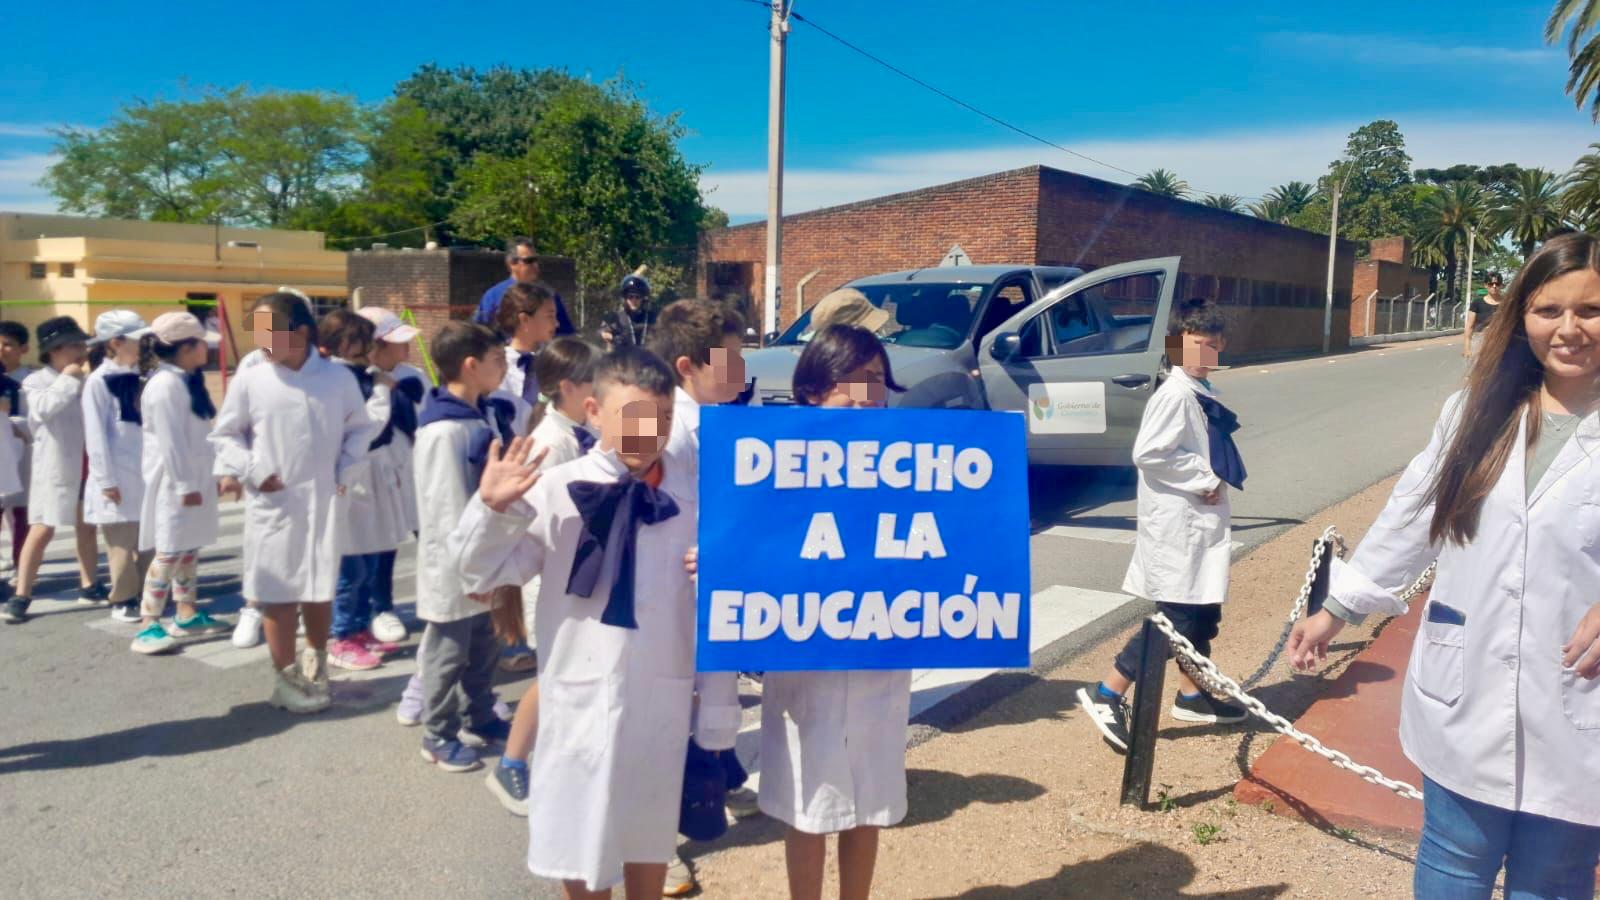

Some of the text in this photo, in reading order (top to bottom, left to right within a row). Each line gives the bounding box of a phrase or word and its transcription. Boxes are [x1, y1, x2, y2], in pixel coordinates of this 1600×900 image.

[735, 437, 993, 491] DERECHO
[800, 511, 947, 559] A LA
[708, 574, 1021, 642] EDUCACIÓN
